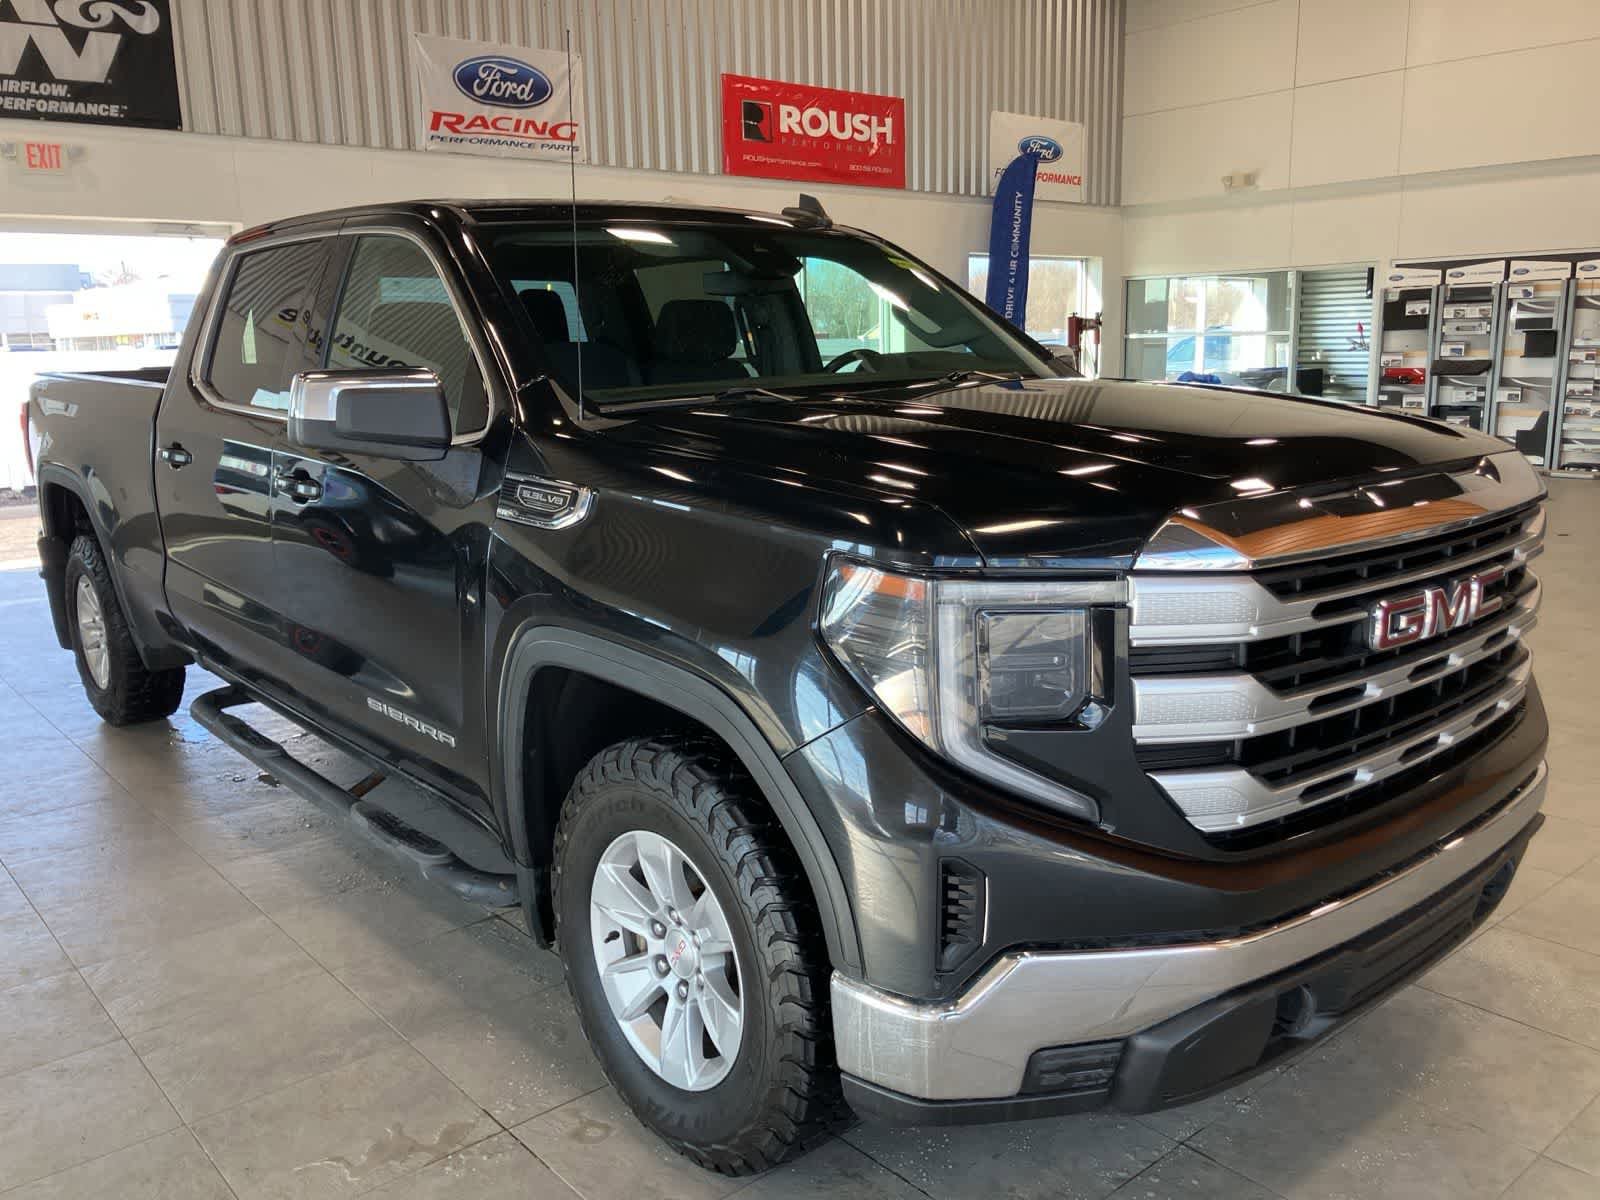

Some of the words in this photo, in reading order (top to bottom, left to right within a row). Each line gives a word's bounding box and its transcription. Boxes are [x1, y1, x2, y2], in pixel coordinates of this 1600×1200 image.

[0, 79, 71, 97] IRFLOW.
[472, 63, 535, 102] Ford
[430, 111, 579, 142] RACING
[779, 105, 893, 145] ROUSH
[26, 143, 61, 169] EXIT
[430, 134, 535, 149] PERFORMANCE
[540, 143, 581, 152] PARTS
[1035, 172, 1082, 186] FORMANCE
[1010, 191, 1024, 257] COMMUNITY
[1009, 260, 1018, 276] UR
[1005, 287, 1015, 319] DRIVE
[1369, 565, 1505, 650] GMC
[366, 696, 456, 749] SIERRA
